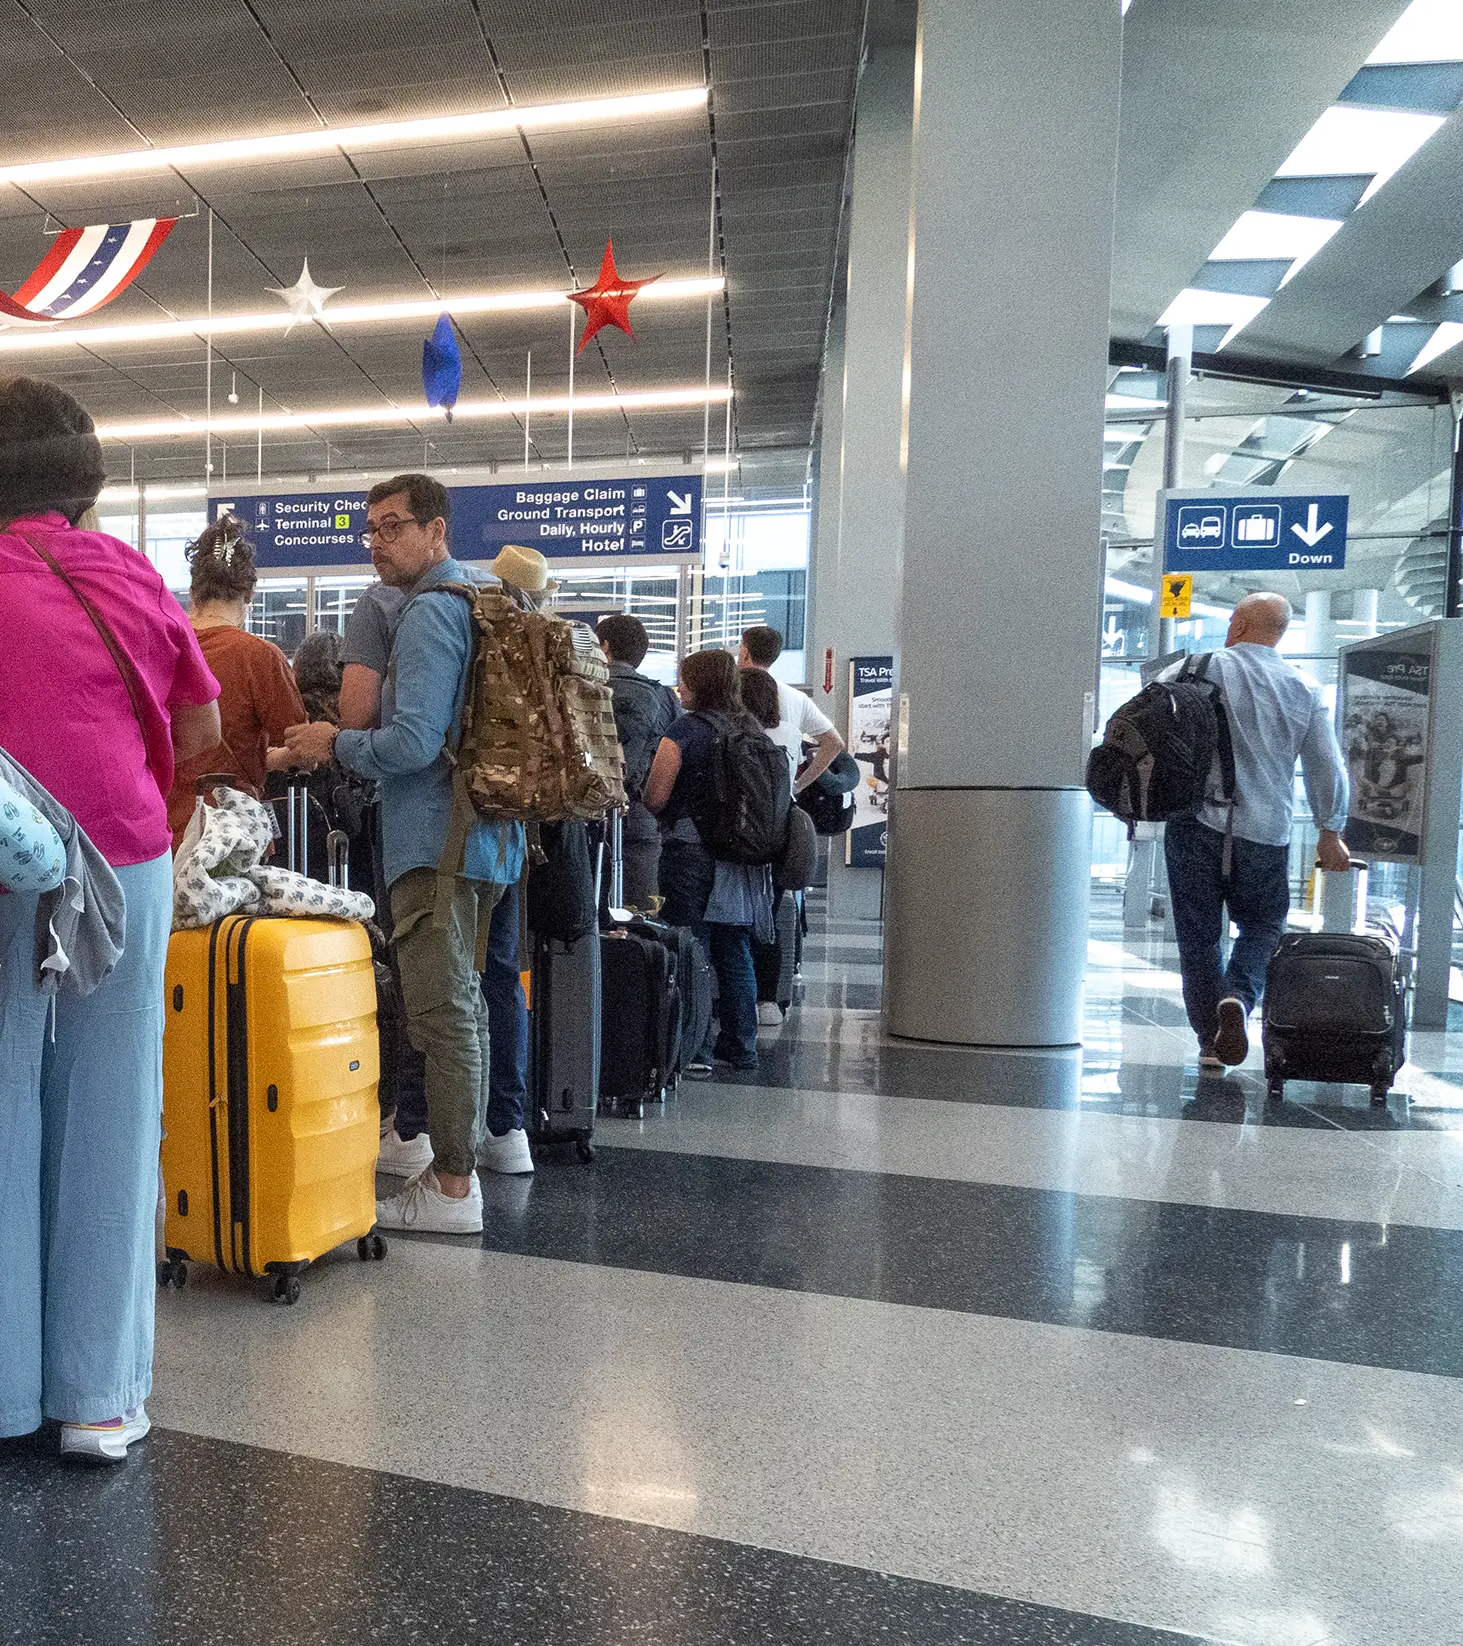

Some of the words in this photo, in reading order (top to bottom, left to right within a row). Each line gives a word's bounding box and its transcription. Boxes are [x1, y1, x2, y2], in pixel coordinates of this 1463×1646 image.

[516, 491, 579, 504] Baggage
[584, 488, 625, 500] Claim
[275, 501, 330, 514] Security
[334, 499, 368, 511] Chec
[497, 507, 550, 521] Ground
[554, 505, 625, 520] Transport
[275, 517, 332, 529] Terminal
[338, 516, 347, 527] 3
[540, 523, 576, 537] Daily,
[580, 521, 625, 536] Hourly
[274, 534, 355, 546] Concourses
[582, 538, 625, 551] Hotel
[1289, 553, 1333, 564] Down
[859, 667, 877, 677] TSA
